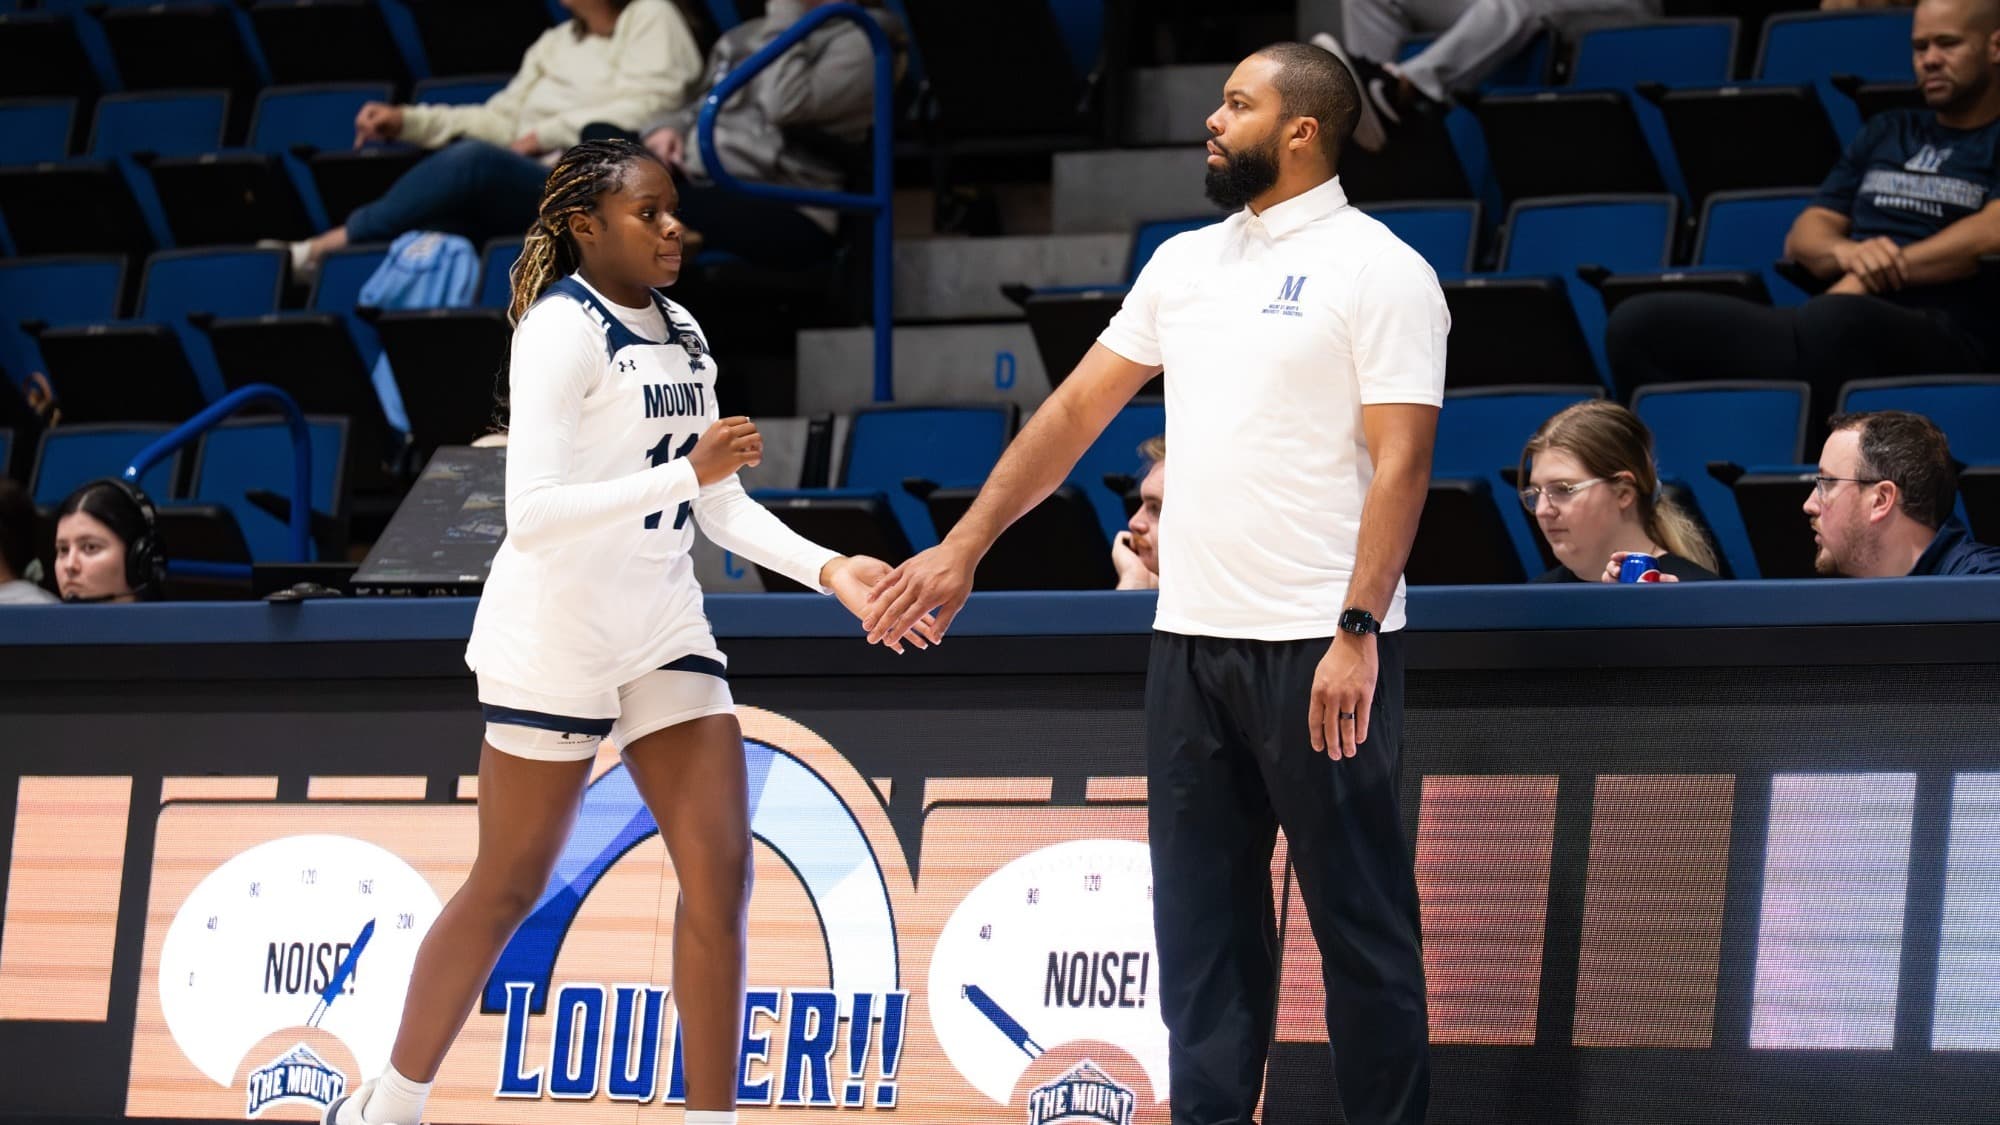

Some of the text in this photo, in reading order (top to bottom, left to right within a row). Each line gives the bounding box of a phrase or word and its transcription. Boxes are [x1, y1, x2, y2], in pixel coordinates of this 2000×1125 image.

[1277, 275, 1307, 302] M
[994, 352, 1016, 390] D
[643, 382, 705, 419] MOUNT
[1084, 874, 1102, 892] 120
[1044, 951, 1150, 1009] NOISE!
[494, 982, 909, 1109] LOUER!!
[250, 1064, 343, 1113] THE MOUNT
[1030, 1082, 1133, 1125] THE MOUNT
